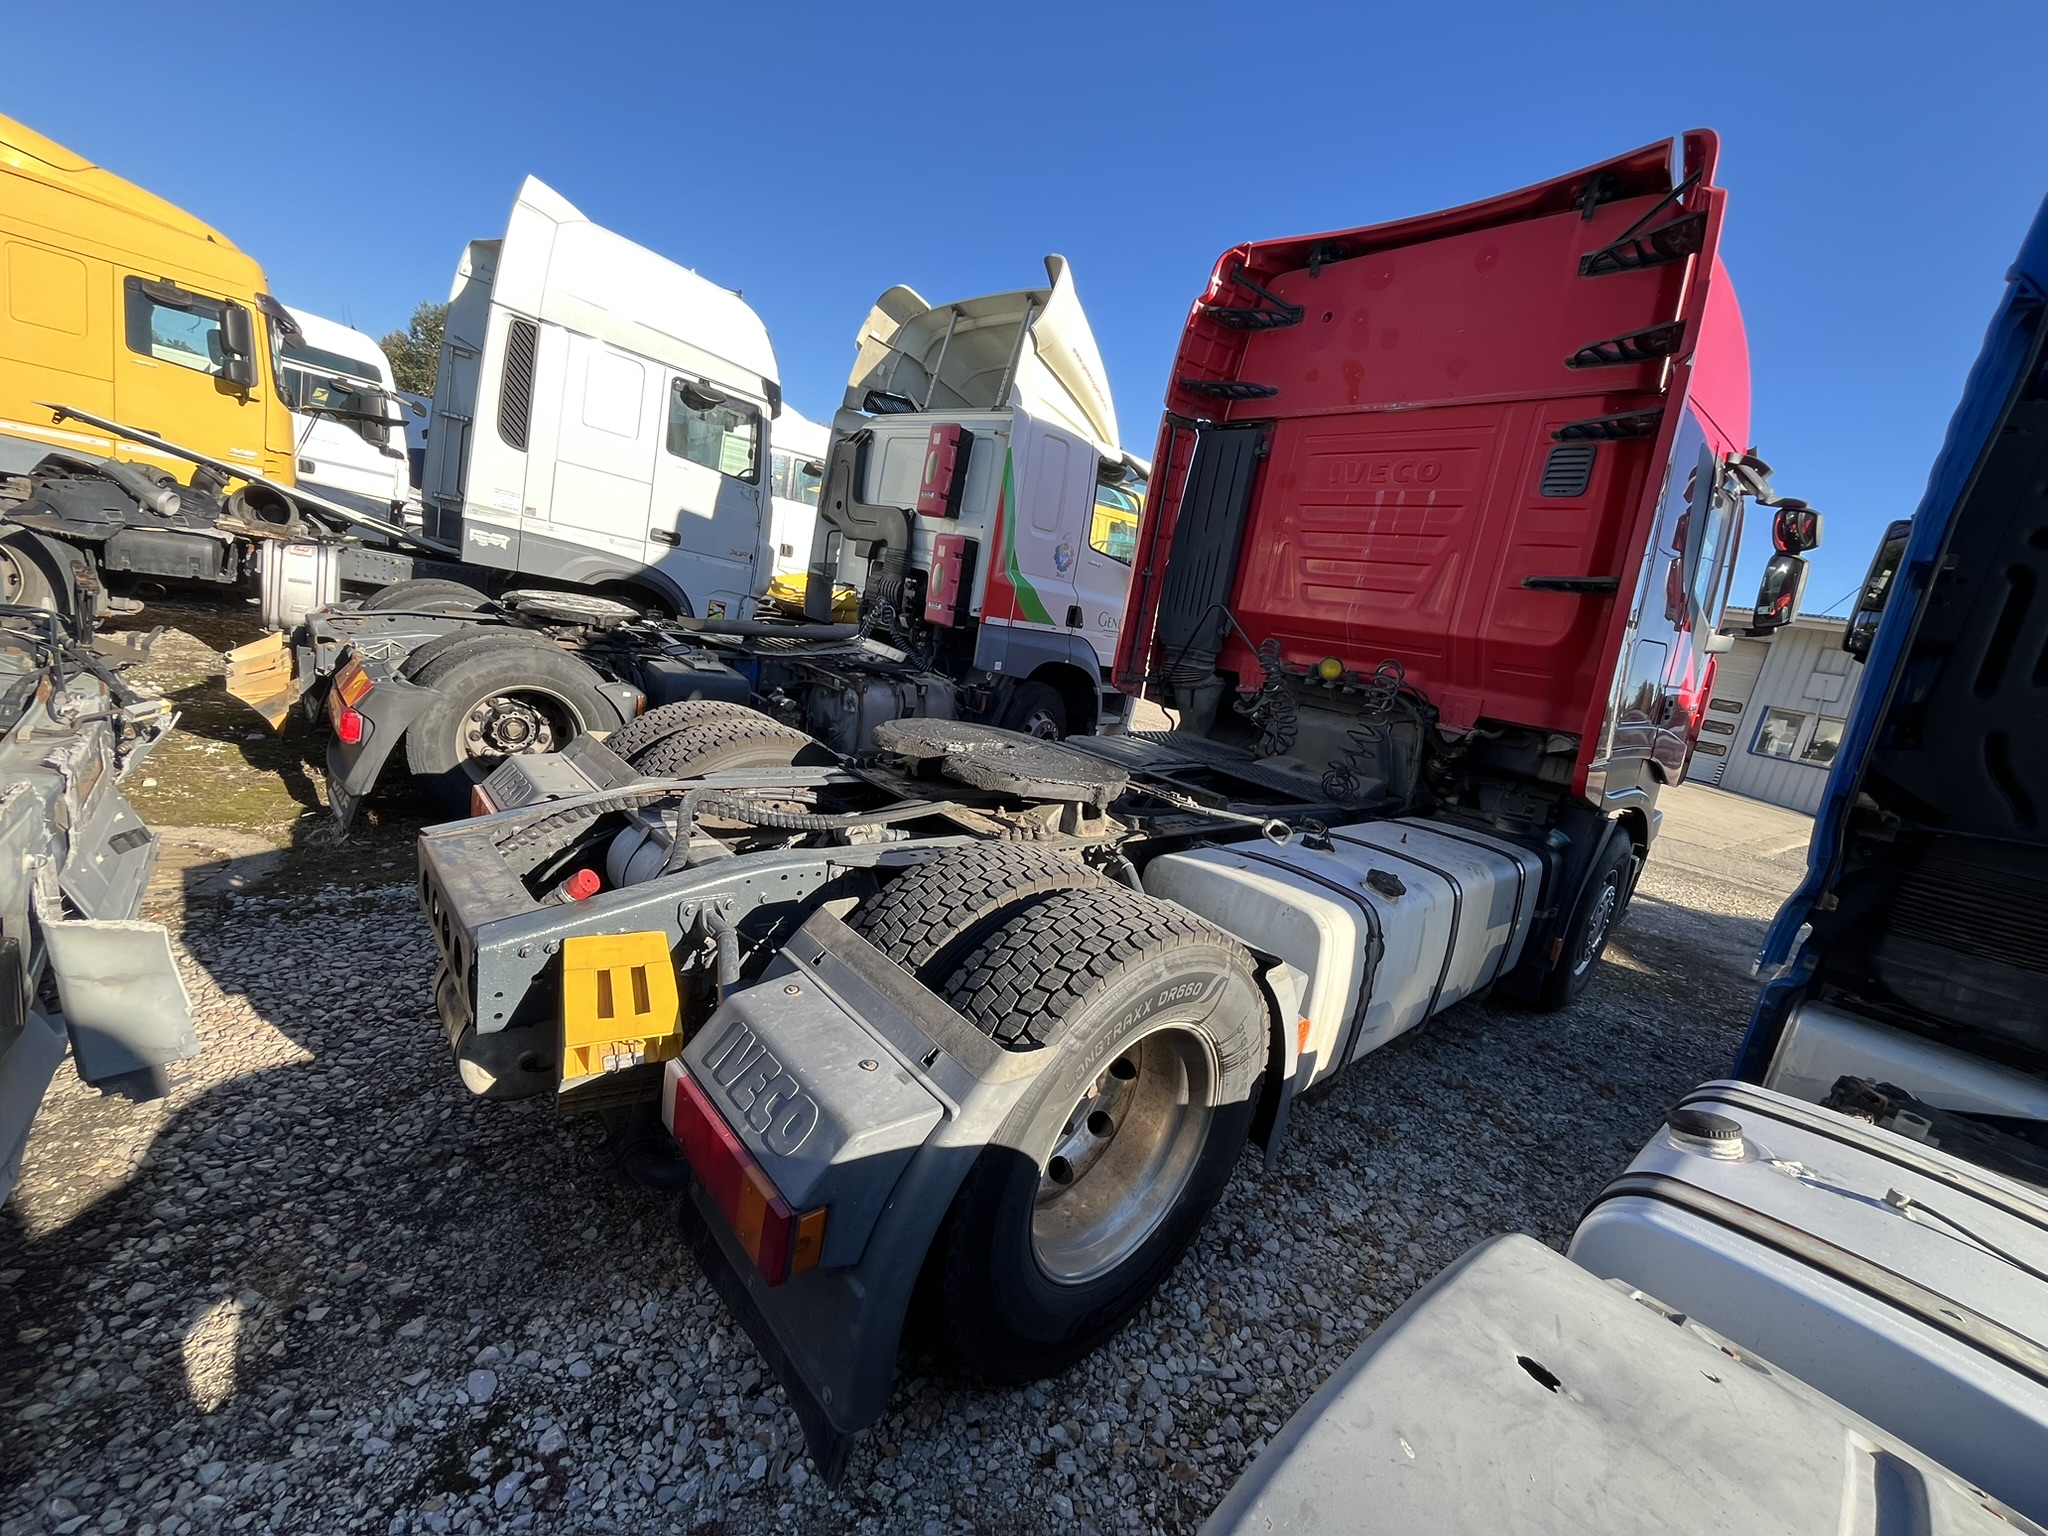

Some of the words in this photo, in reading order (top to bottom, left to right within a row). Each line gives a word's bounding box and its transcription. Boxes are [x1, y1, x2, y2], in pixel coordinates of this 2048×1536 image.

[1329, 459, 1441, 483] IVECO
[489, 763, 532, 807] IVECO
[1065, 998, 1153, 1093] LONGTRAXX
[1158, 981, 1203, 1006] DR660
[701, 1022, 819, 1157] IVECO
